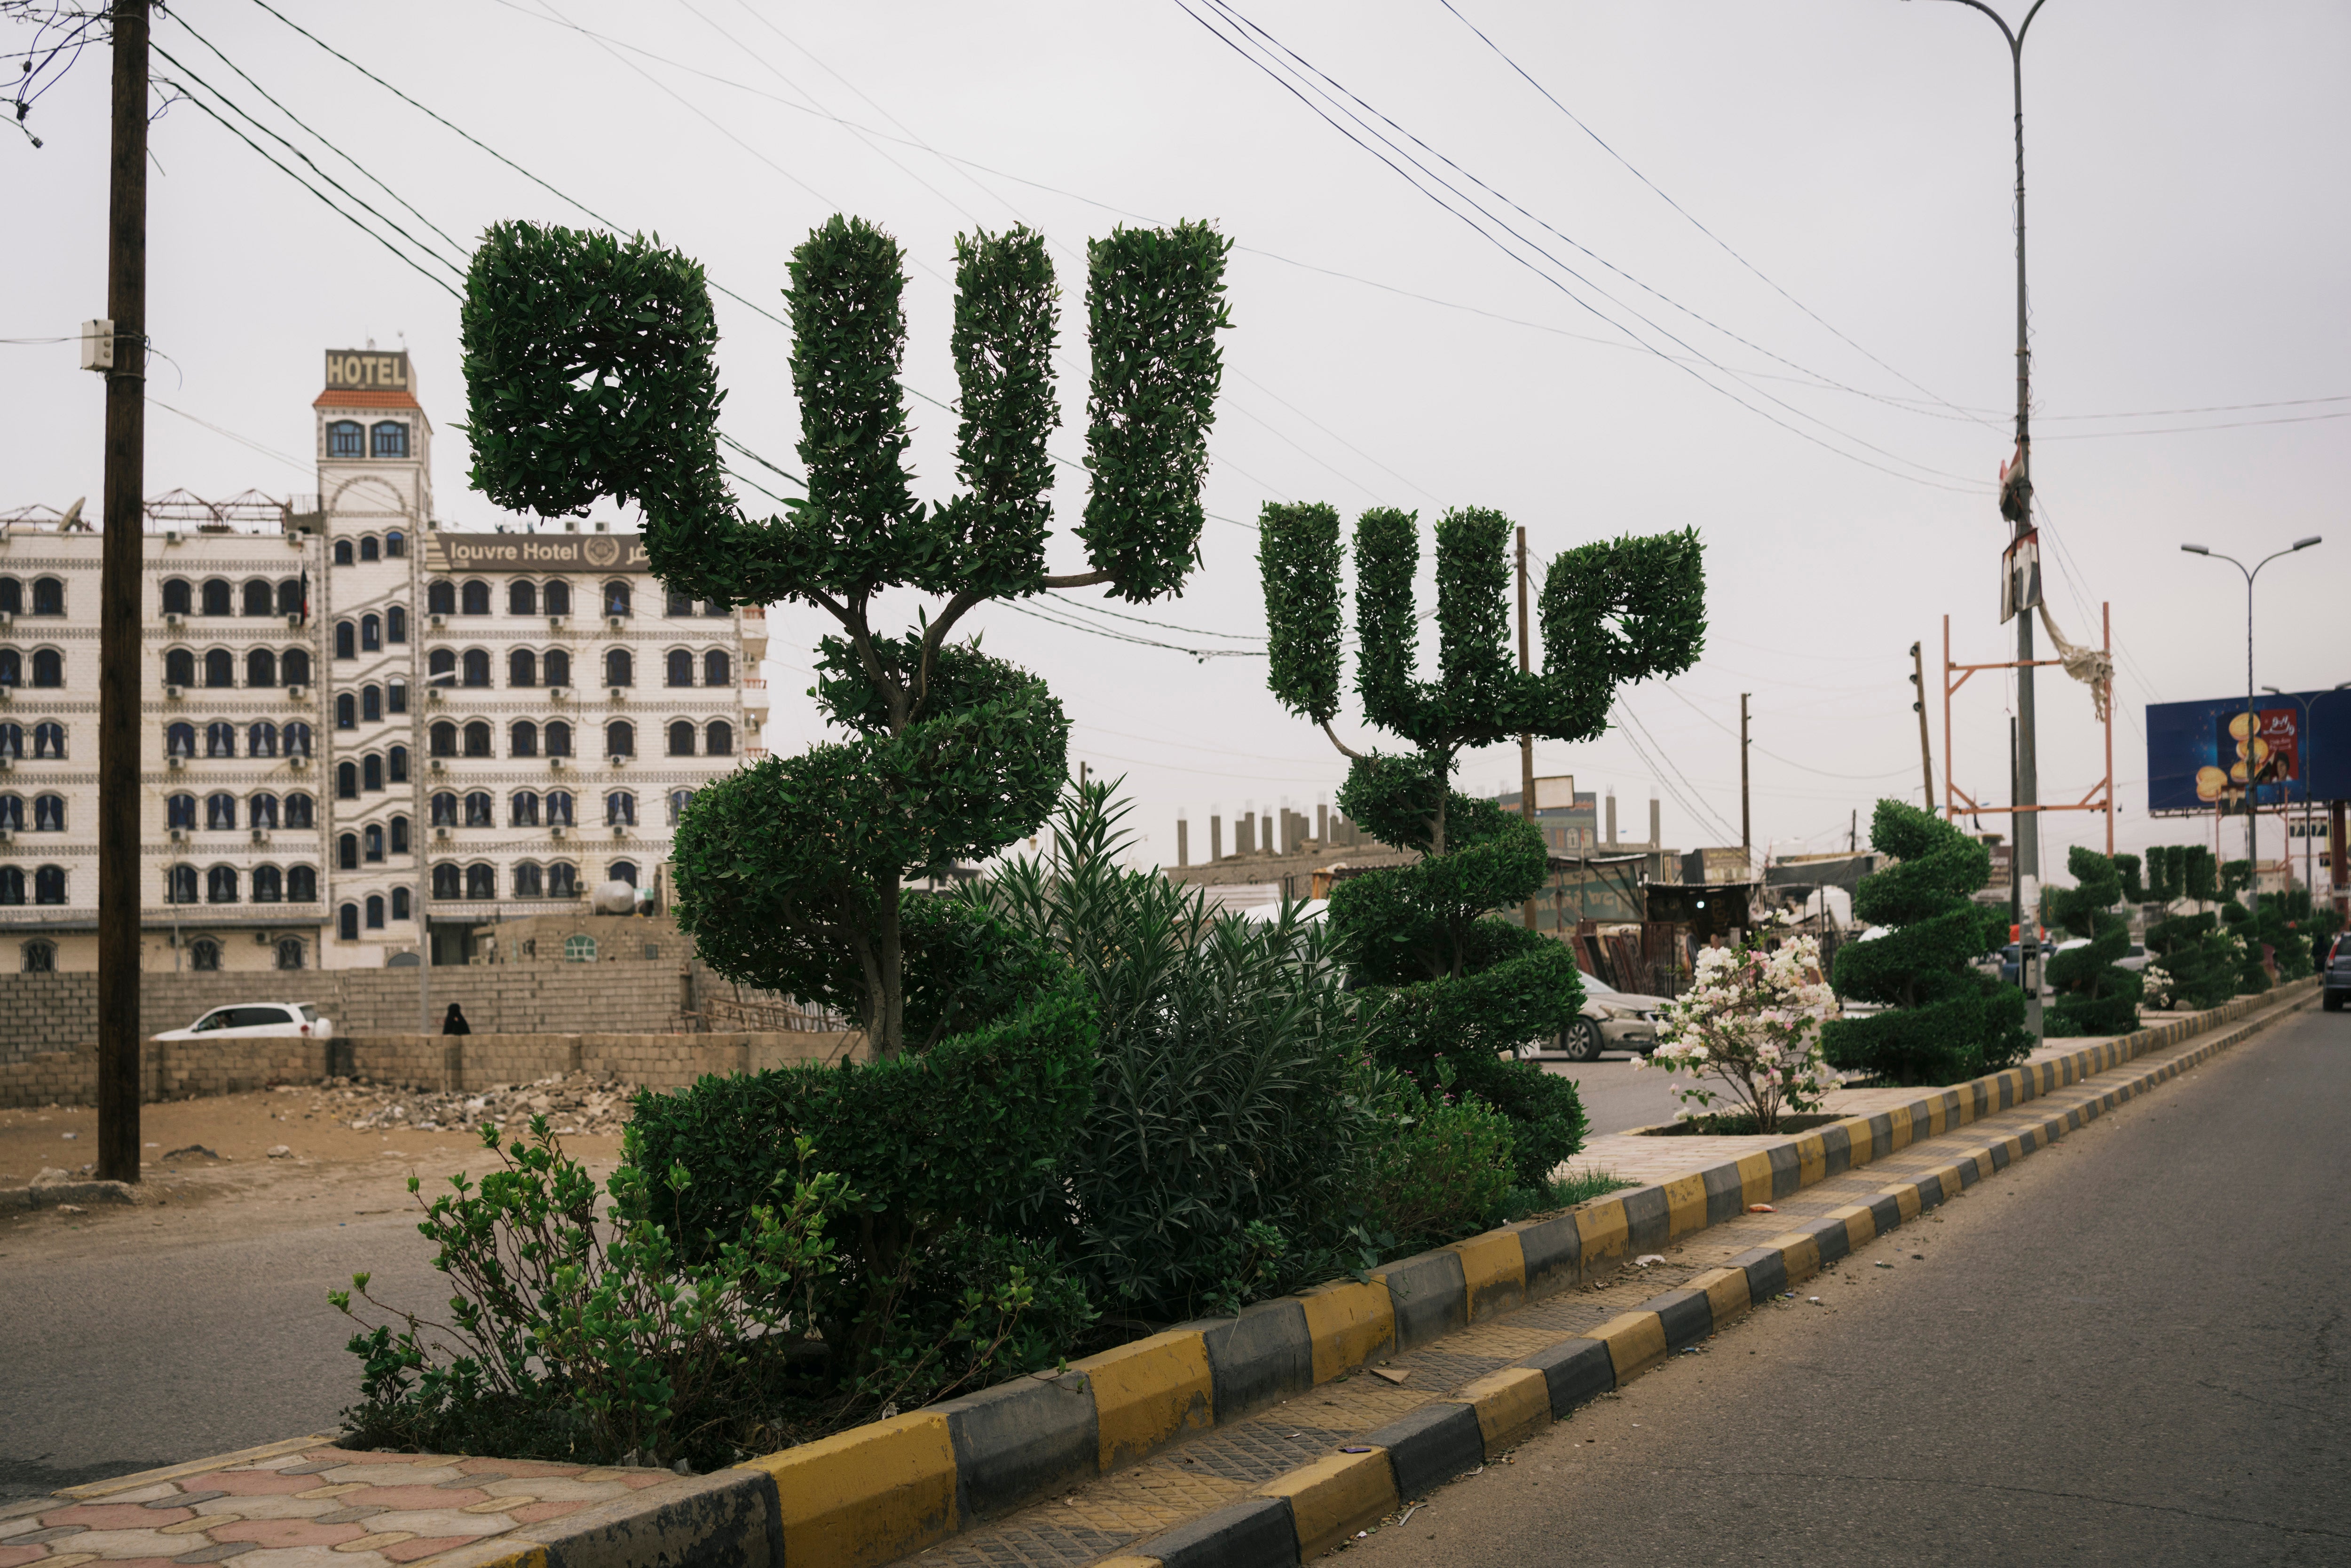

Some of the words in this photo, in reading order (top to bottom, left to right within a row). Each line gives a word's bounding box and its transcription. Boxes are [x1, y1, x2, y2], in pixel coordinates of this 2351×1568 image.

[327, 355, 406, 385] HOTEL
[451, 541, 518, 560] louvre
[523, 542, 578, 560] Hotel
